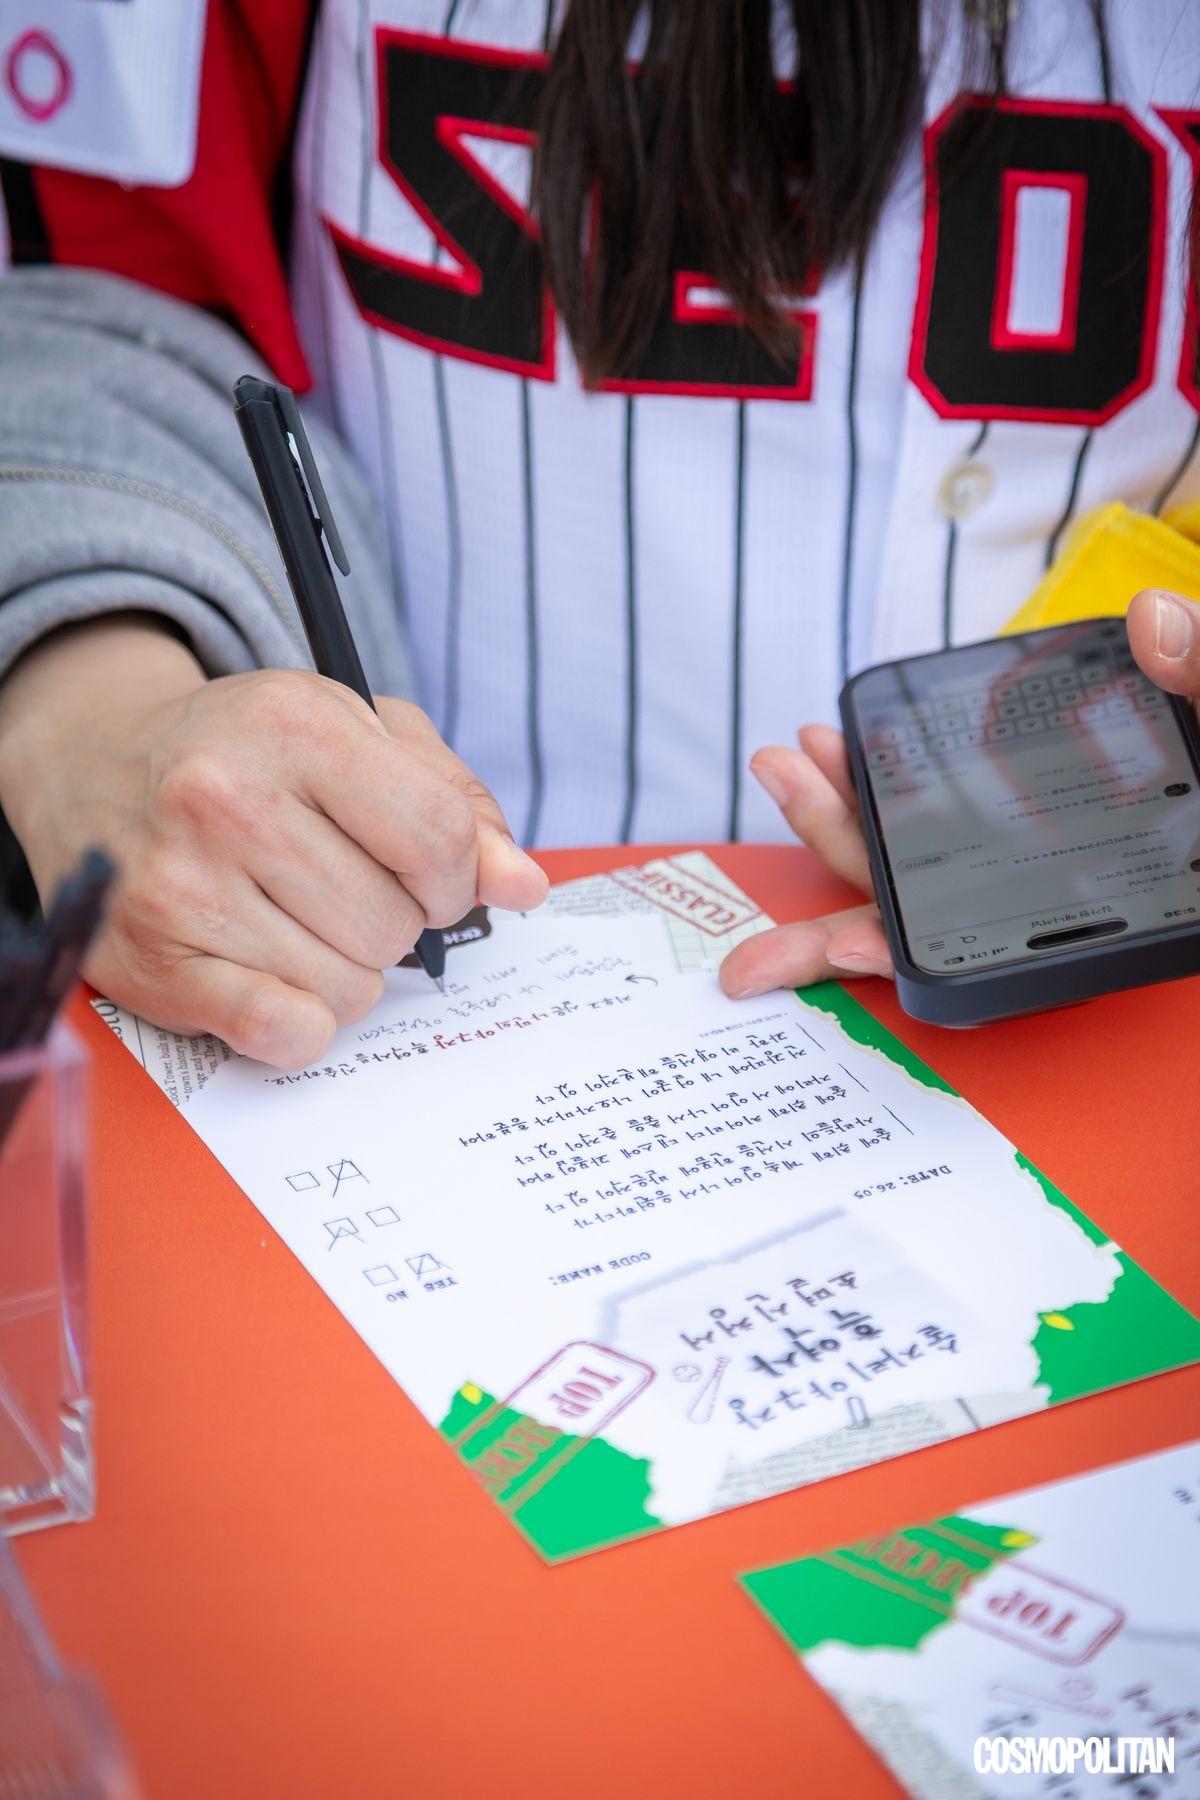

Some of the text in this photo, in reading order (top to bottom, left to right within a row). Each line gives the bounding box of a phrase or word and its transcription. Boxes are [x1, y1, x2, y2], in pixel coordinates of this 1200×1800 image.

[321, 27, 1200, 427] SO
[550, 1000, 579, 1017] 싶은
[587, 995, 632, 1010] 지우고
[494, 1013, 549, 1031] 나만의
[432, 1029, 496, 1050] 야구장
[745, 1031, 788, 1049] 과한
[458, 1045, 807, 1147] 전광판에 내 얼굴이 나오자마자 흥분하여
[814, 1085, 846, 1105] 술에
[767, 1099, 807, 1118] 취해
[626, 1115, 660, 1132] 춤을
[685, 1115, 762, 1141] 치어리더
[800, 1116, 873, 1142] 사람들의
[619, 1133, 680, 1159] 댄스에
[736, 1139, 793, 1158] 시선을
[858, 1127, 891, 1149] 술에
[678, 1152, 735, 1177] 한몸에
[811, 1142, 851, 1162] 취해
[853, 1165, 953, 1200] DATE: 26.05
[573, 1189, 672, 1229] 응원하다가
[549, 1251, 652, 1286] CODE NAME:
[386, 1276, 458, 1302] YES NO
[549, 1366, 623, 1423] TOP
[986, 1590, 1079, 1642] TOP
